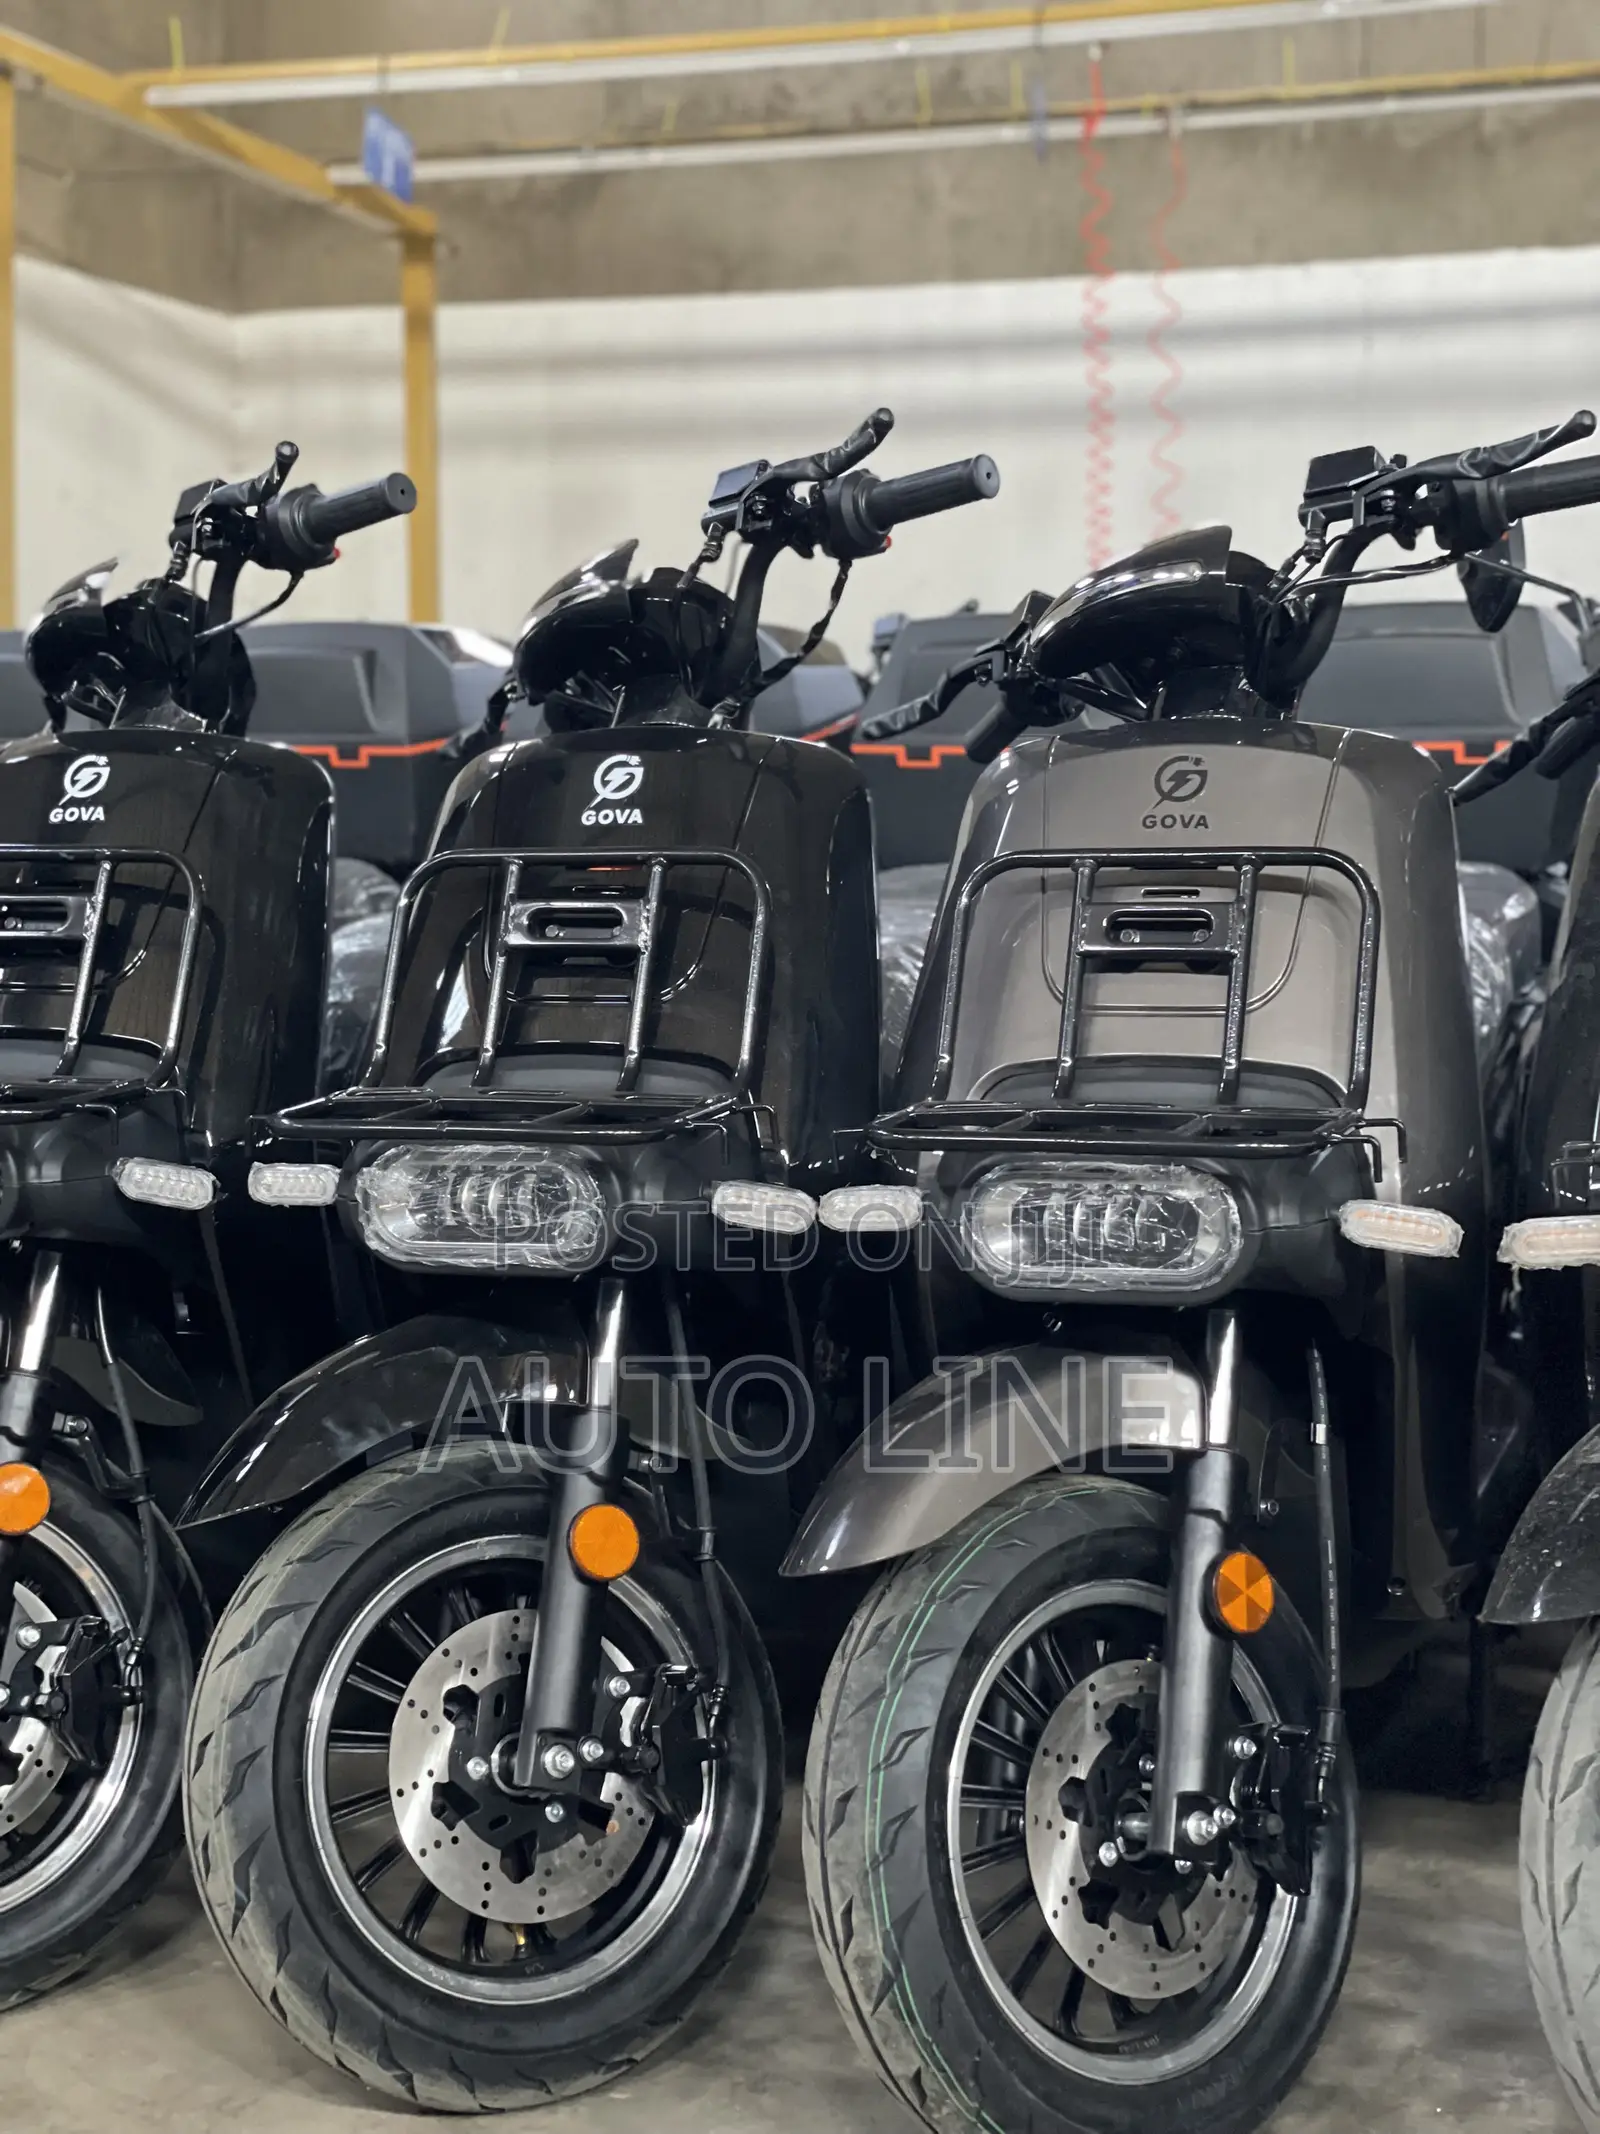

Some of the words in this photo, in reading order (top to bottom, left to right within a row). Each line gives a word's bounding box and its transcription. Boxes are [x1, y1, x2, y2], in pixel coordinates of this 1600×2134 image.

[48, 806, 105, 823] GOVA
[581, 808, 643, 826] GOVA
[1141, 814, 1209, 829] GOVA
